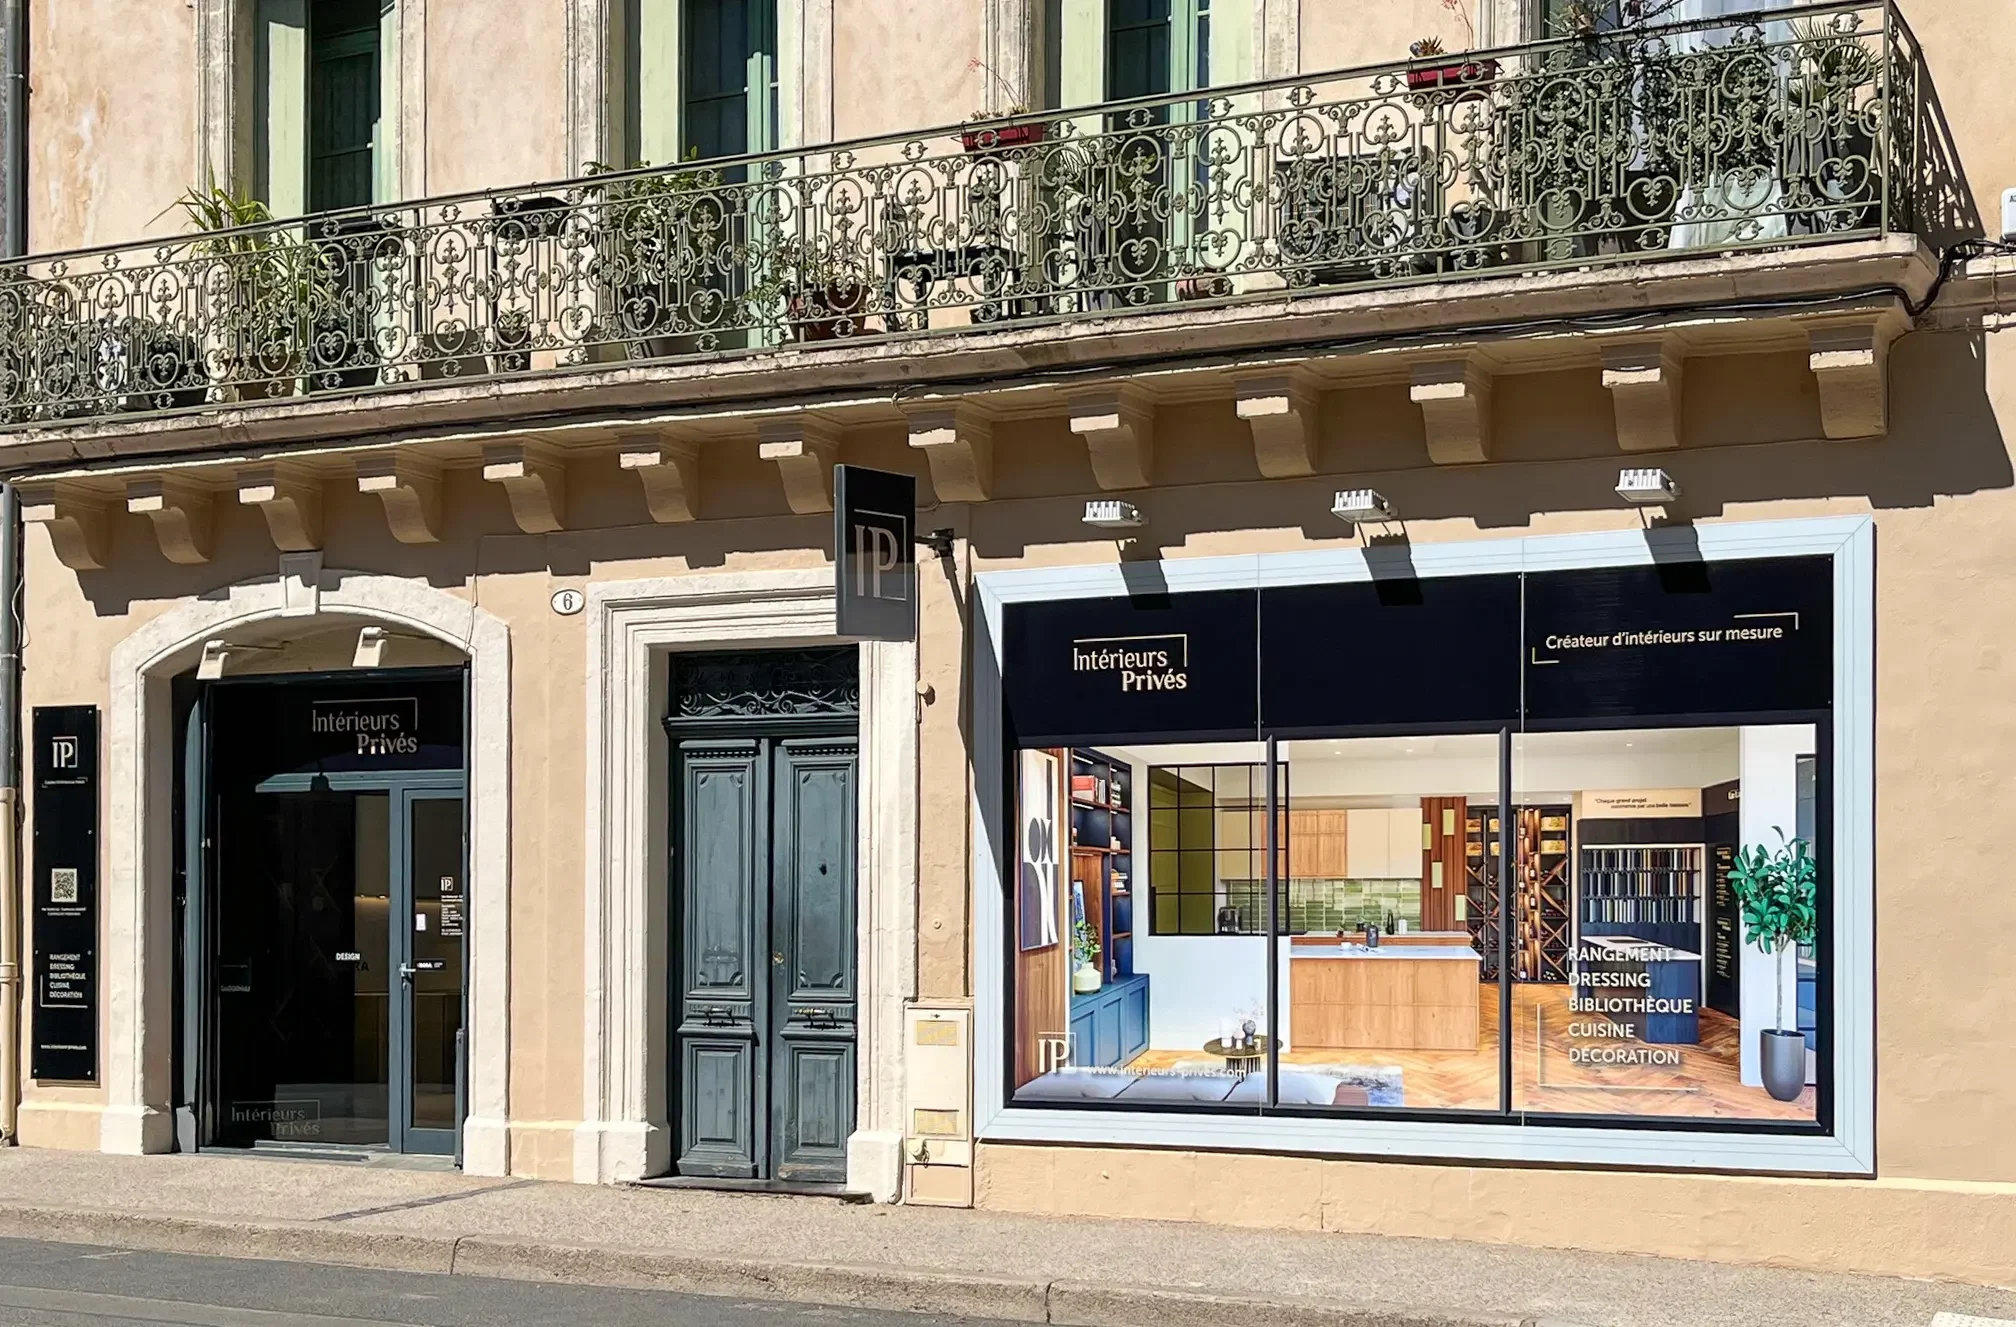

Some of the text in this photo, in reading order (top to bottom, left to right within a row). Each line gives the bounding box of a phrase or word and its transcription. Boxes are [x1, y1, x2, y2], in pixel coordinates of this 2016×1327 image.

[855, 524, 898, 599] IP
[563, 592, 573, 611] 6
[1545, 626, 1783, 649] Créateur d'intérieurs sur mesure
[1073, 647, 1168, 671] Intérieurs
[1121, 668, 1187, 692] Privés
[312, 709, 399, 732] Intérieurs
[356, 732, 417, 755] Privés
[52, 741, 73, 768] IP
[335, 952, 361, 961] DESIGN
[1568, 947, 1674, 962] RANGEMENT
[1568, 972, 1651, 987] DRESSING
[1568, 995, 1693, 1014] BIBLIOTHÈQUE
[1568, 1023, 1635, 1038] CUISINE
[231, 1106, 306, 1122] Intérieurs
